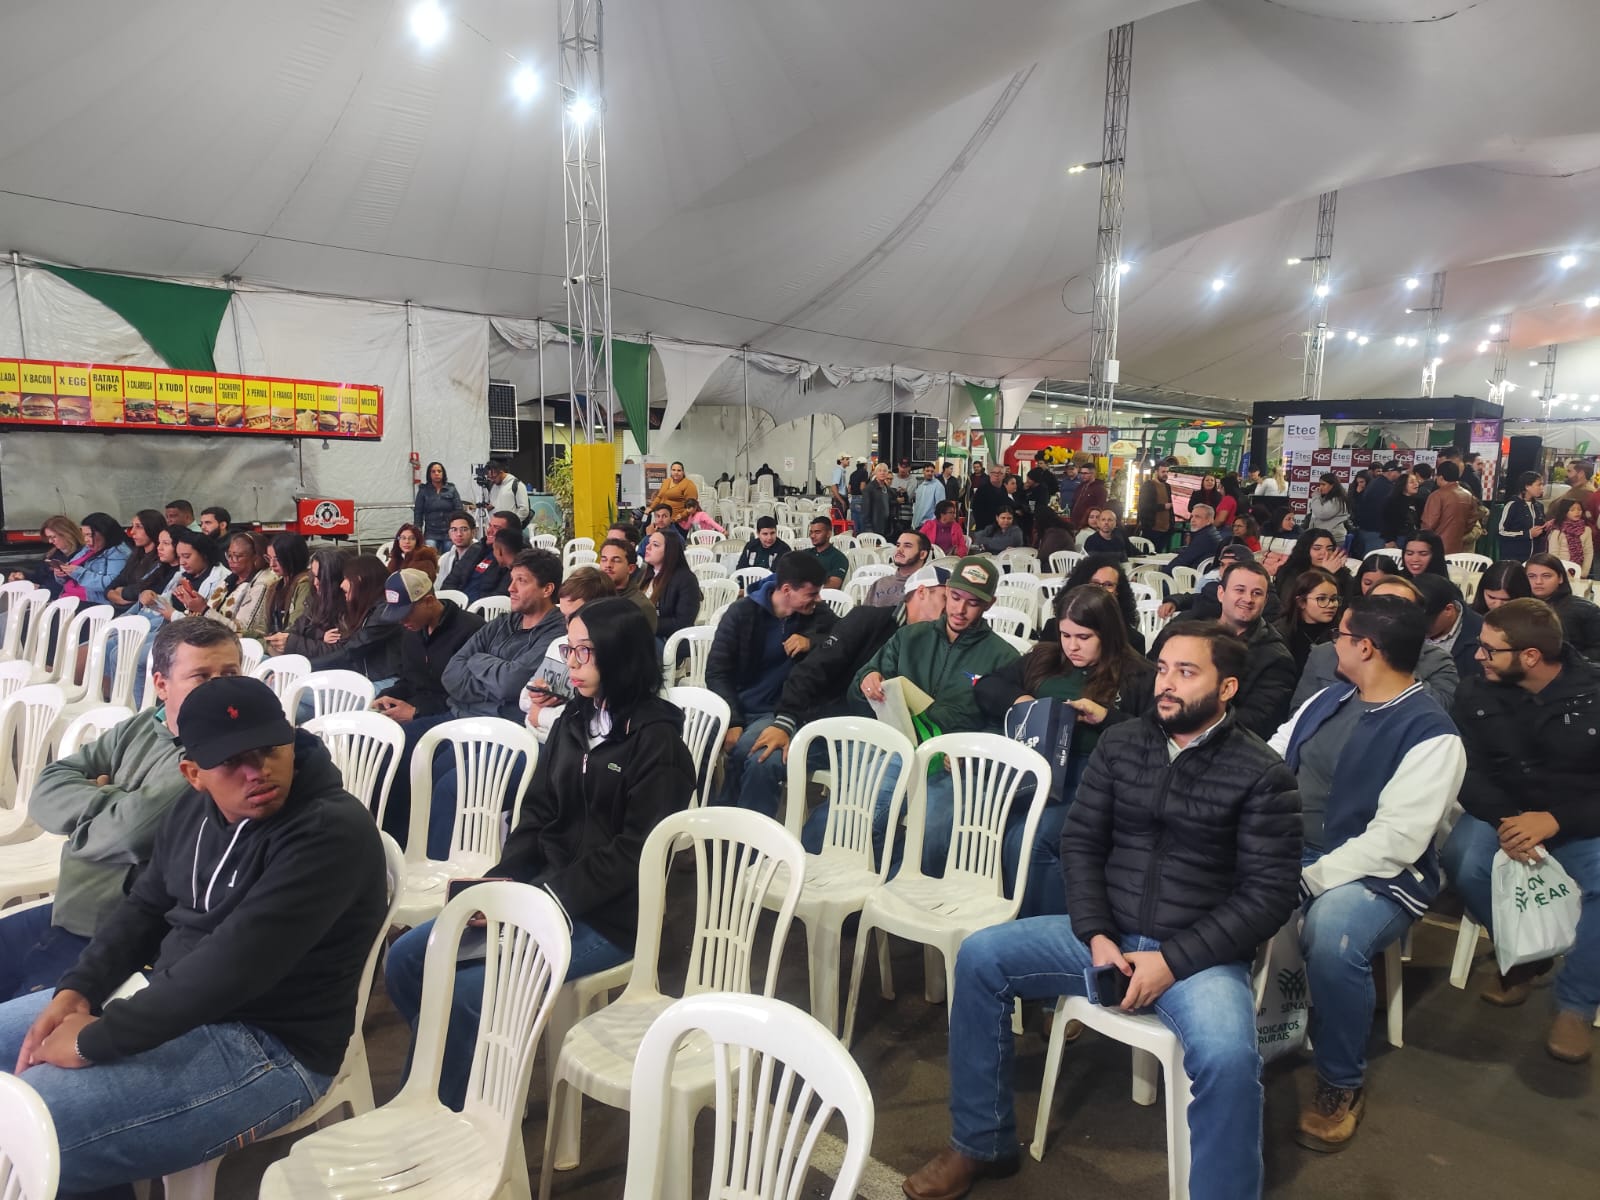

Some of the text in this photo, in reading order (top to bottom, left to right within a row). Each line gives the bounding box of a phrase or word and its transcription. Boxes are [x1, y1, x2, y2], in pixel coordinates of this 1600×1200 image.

[0, 372, 16, 382] LADA
[30, 374, 52, 384] BACON
[59, 376, 87, 387] X EGG
[93, 373, 120, 383] BATATA
[96, 383, 118, 392] CHIPS
[166, 383, 184, 392] TUDO
[195, 385, 213, 394] CUPIM
[297, 392, 316, 402] PASTEL
[1287, 424, 1316, 435] Etec
[1373, 453, 1392, 461] Etec
[1257, 1020, 1299, 1034] NDICATOS
[1258, 1032, 1290, 1044] RURAIS
